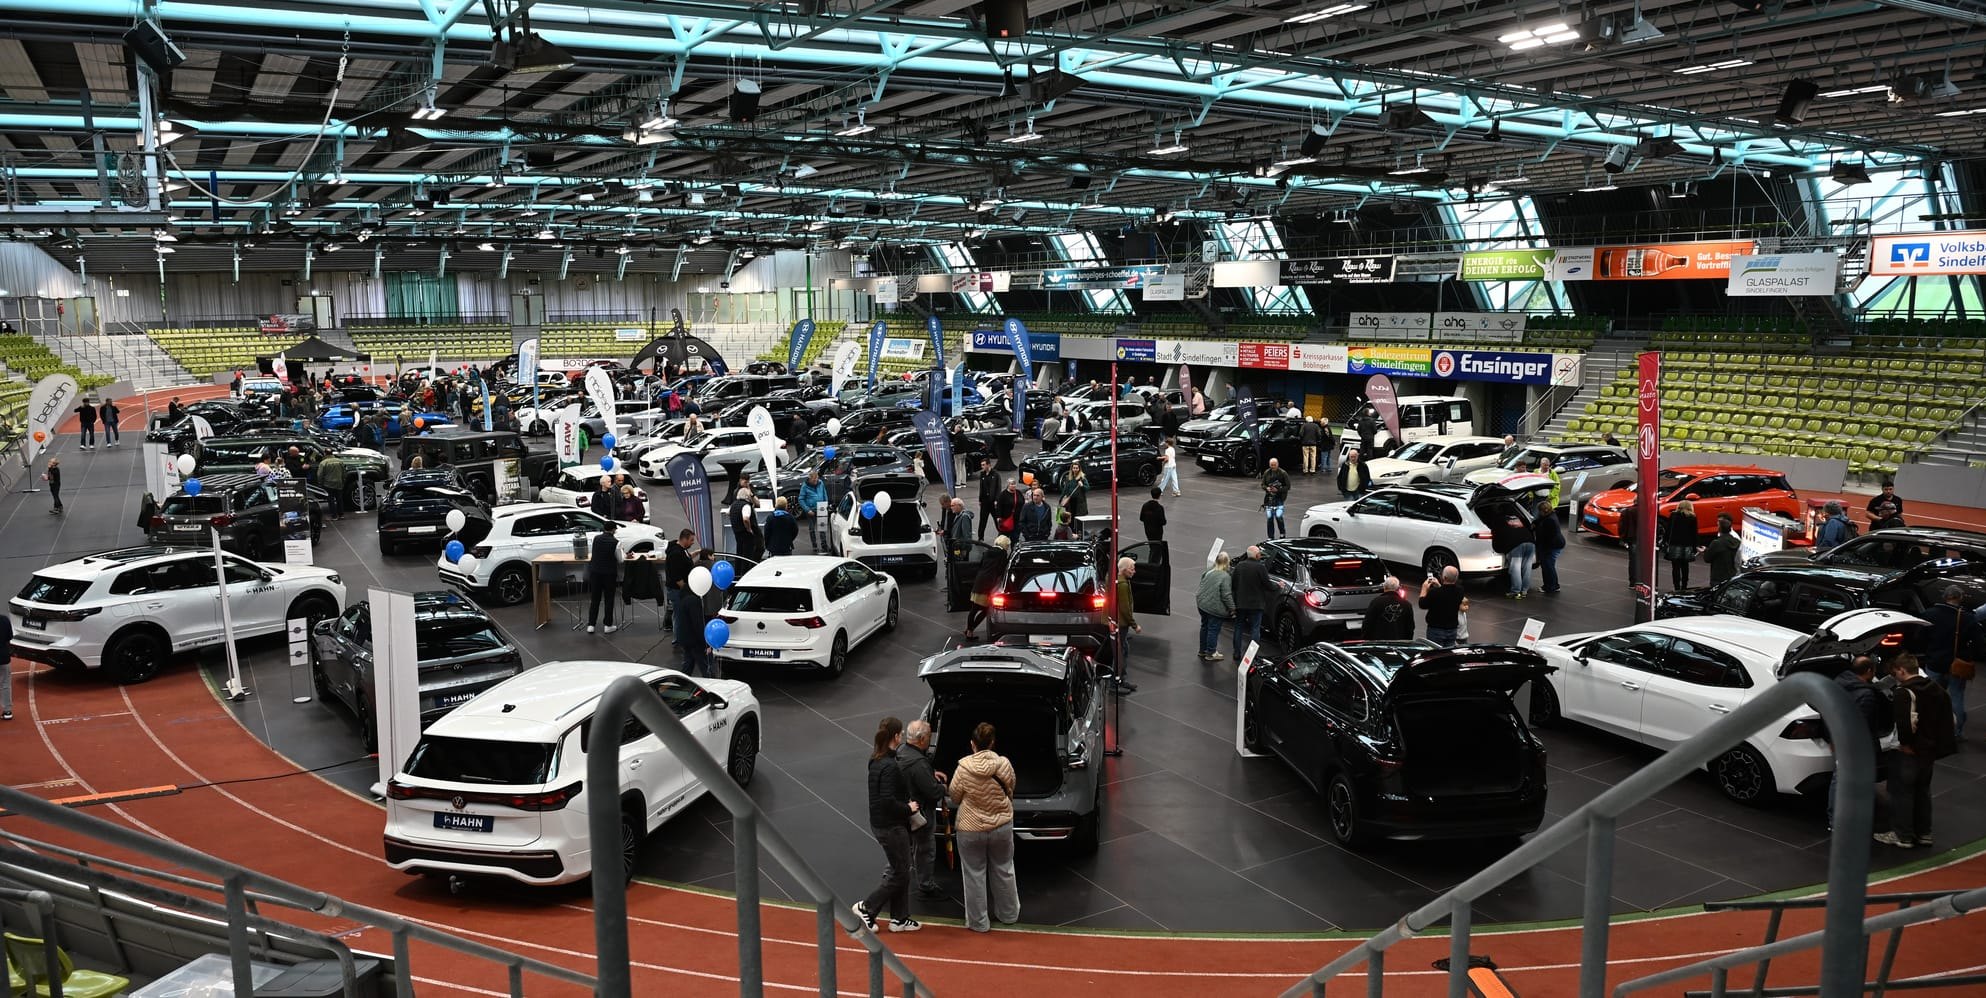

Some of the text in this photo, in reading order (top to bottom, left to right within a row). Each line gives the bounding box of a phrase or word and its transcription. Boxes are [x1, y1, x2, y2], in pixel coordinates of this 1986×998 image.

[1940, 241, 1986, 253] Volksb
[1466, 256, 1505, 266] ENERGIE
[1465, 264, 1537, 275] DEINEN ERFOLG
[1746, 278, 1809, 287] GLASPALAST
[1358, 315, 1379, 329] ahg
[1444, 316, 1466, 331] ahg
[988, 335, 1011, 344] HYUN
[1014, 334, 1030, 367] HYUNDAI
[1032, 343, 1056, 351] HYUNDAI
[1264, 347, 1288, 358] PETERS
[1157, 352, 1172, 361] Stadt
[1182, 352, 1222, 364] Sindelfingen
[1303, 353, 1343, 363] Kreissparkasse
[1370, 349, 1428, 360] Badezentrum
[1303, 361, 1330, 370] Böblingen
[1370, 359, 1426, 371] Sindelfingen
[1460, 353, 1548, 380] Ensinger
[252, 585, 275, 594] HAHN
[754, 649, 775, 657] HAHN
[450, 693, 476, 703] HAHN
[712, 718, 728, 730] HAHN
[452, 816, 484, 828] HAHN
